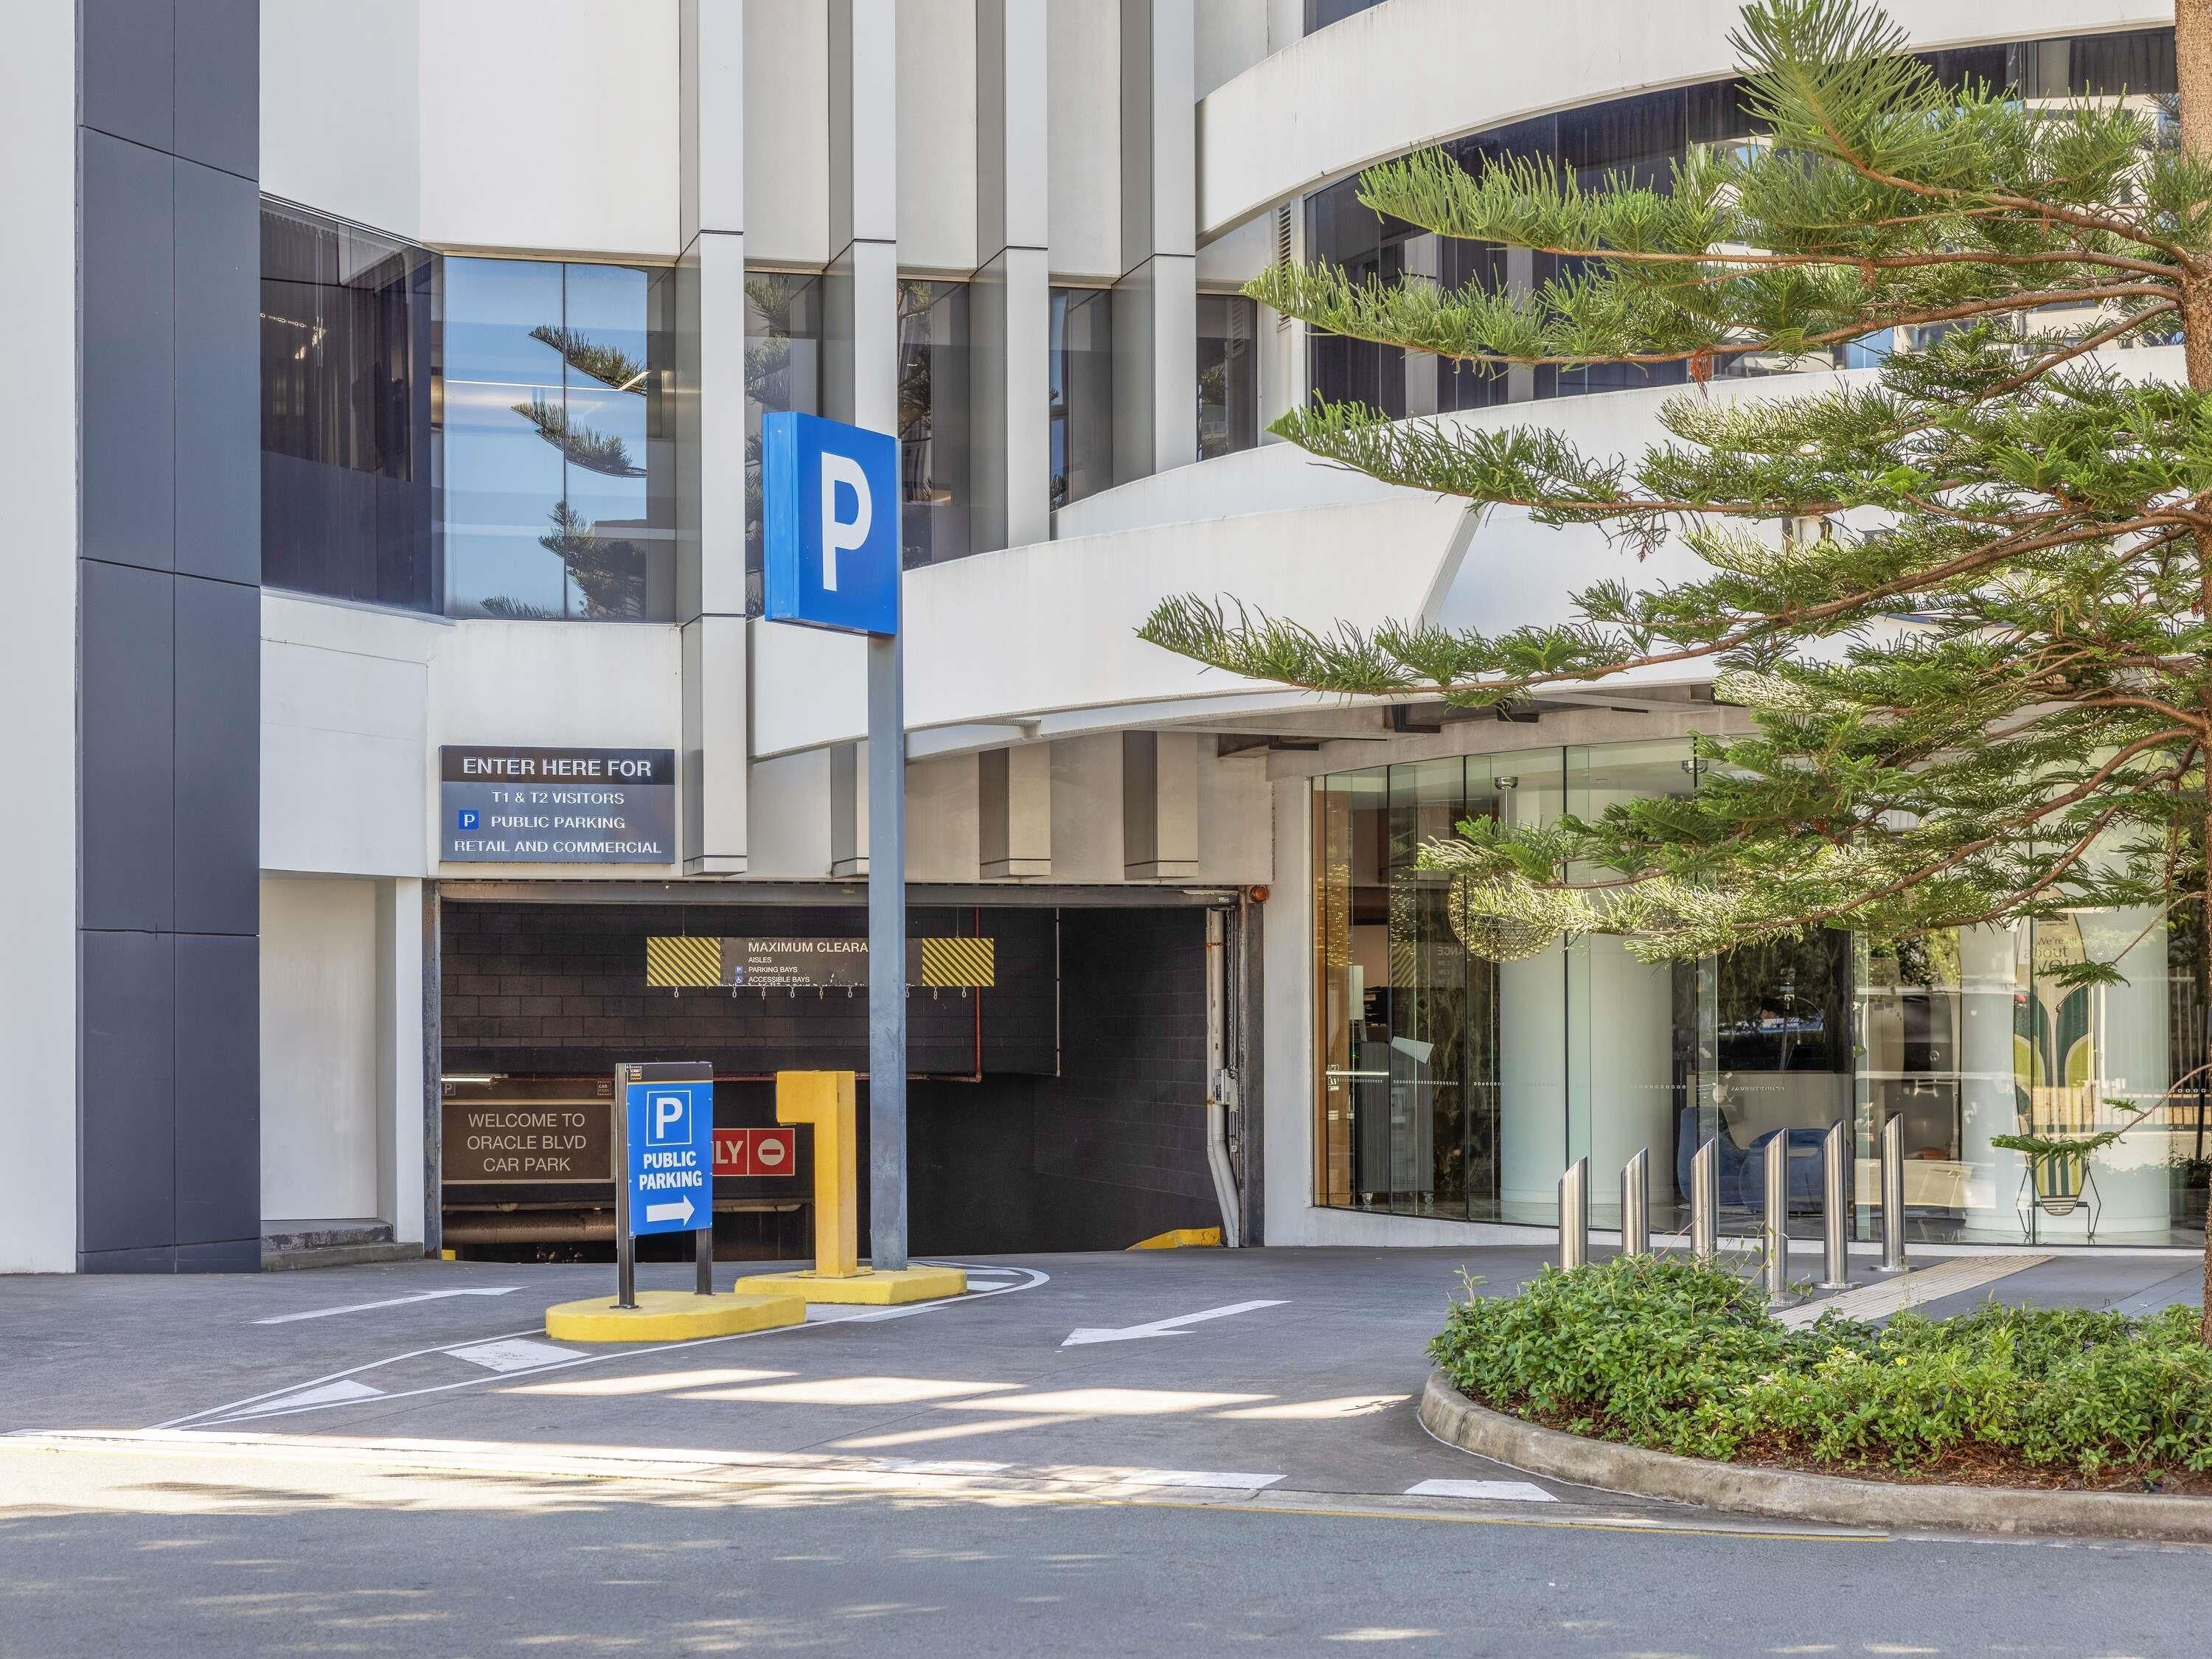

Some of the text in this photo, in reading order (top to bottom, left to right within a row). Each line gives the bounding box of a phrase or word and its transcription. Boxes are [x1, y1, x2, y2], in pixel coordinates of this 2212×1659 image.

[821, 451, 872, 592] P
[463, 757, 651, 776] ENTER HERE FOR
[491, 791, 625, 804] T1 & T2 VISITORS
[464, 815, 625, 829] P PUBLIC PARKING
[454, 840, 662, 853] RETAIL AND COMMERCIAL
[748, 942, 813, 953] MAXIMUM
[444, 1083, 452, 1095] P
[468, 1113, 585, 1127] WELCOME TO
[656, 1097, 683, 1139] P
[467, 1135, 586, 1150] ORACLE BLVD
[644, 1151, 697, 1169] PUBLIC
[712, 1141, 743, 1164] LY
[483, 1157, 571, 1172] CAR PARK
[639, 1170, 703, 1191] PARKING
